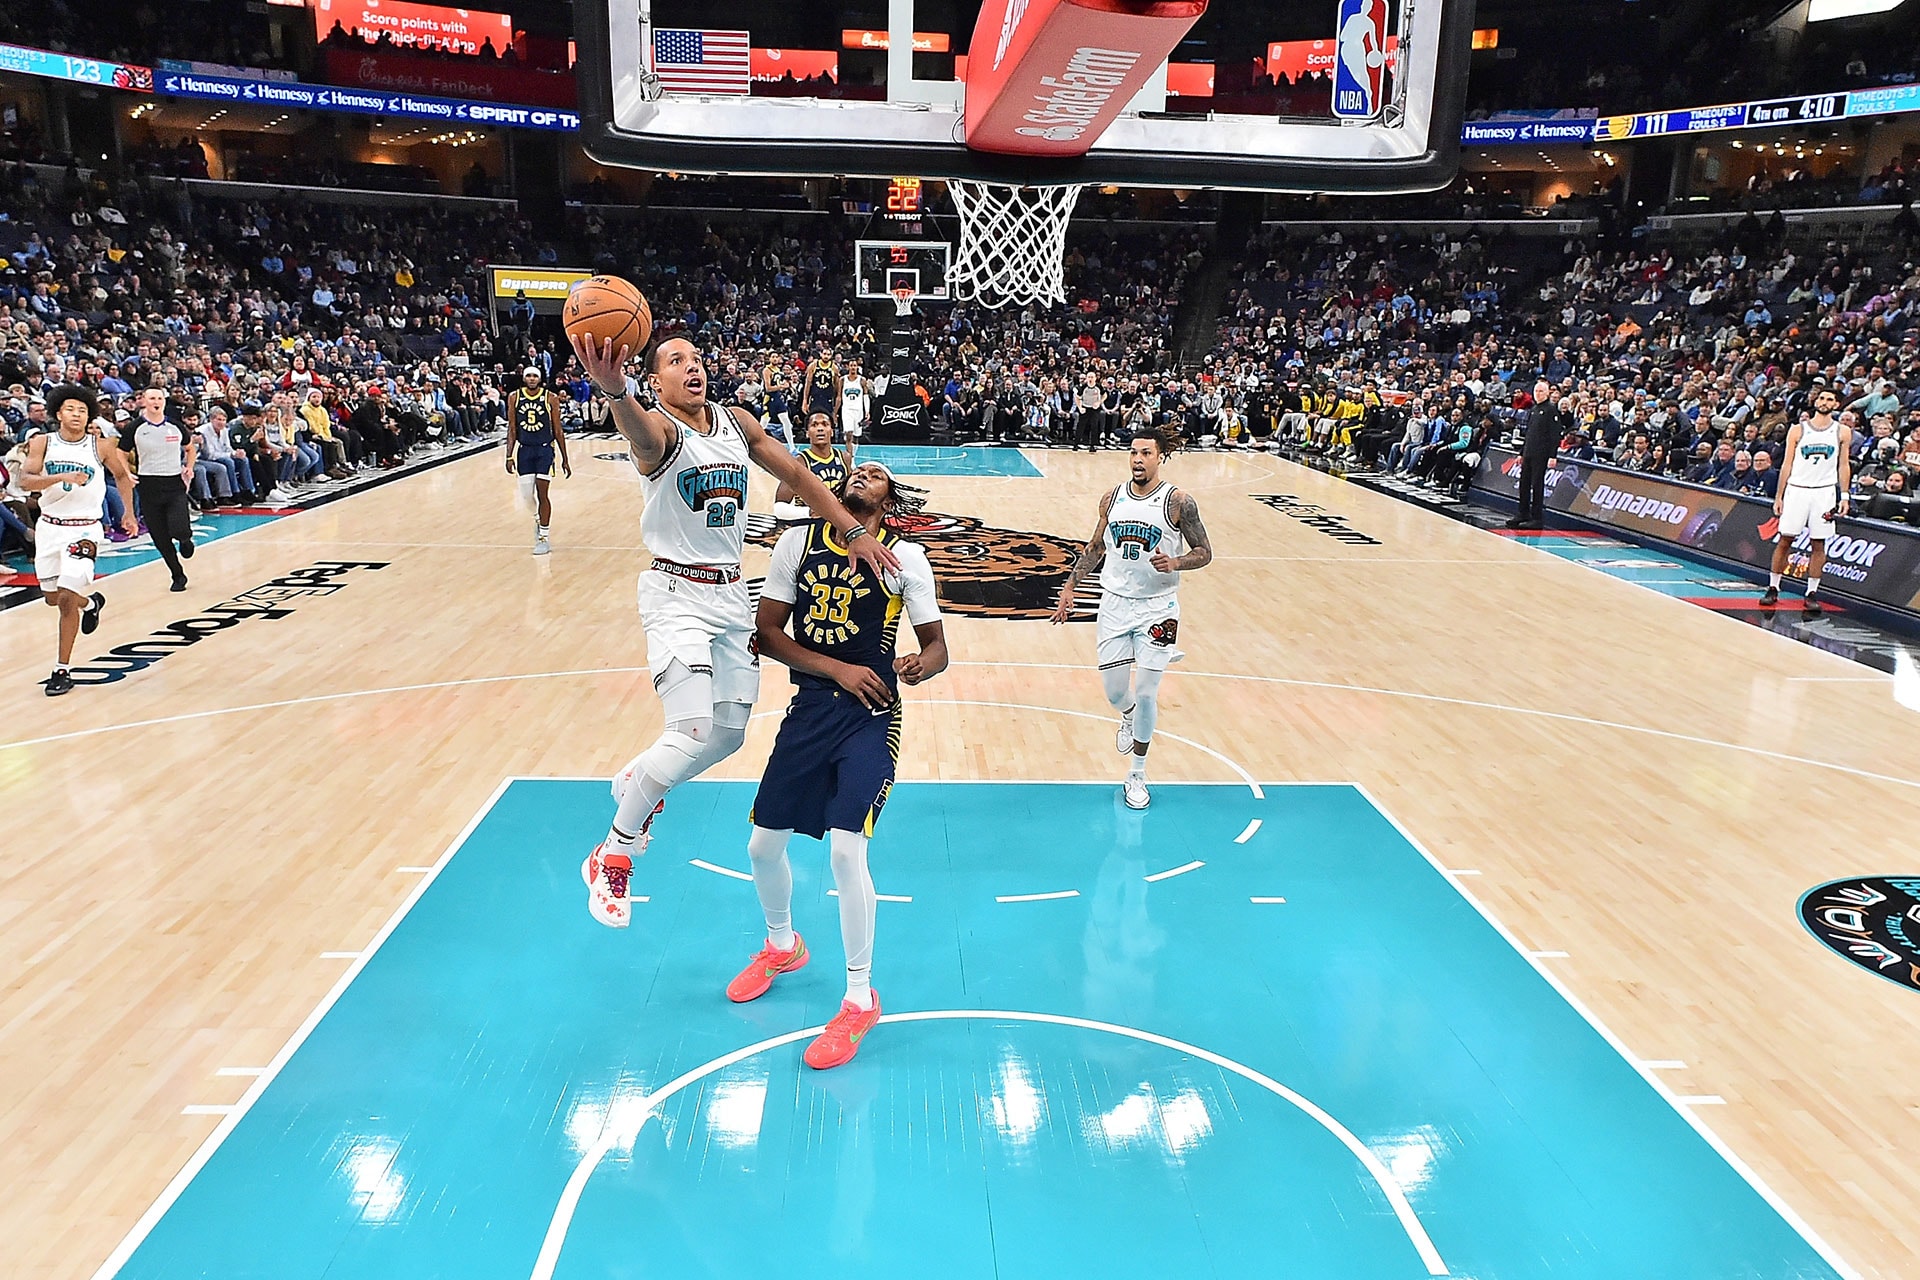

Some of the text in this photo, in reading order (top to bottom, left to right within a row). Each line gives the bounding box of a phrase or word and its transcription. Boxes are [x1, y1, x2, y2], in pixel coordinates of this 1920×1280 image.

[357, 27, 380, 40] the
[362, 11, 467, 34] Score points with
[63, 57, 101, 81] 123
[1307, 54, 1336, 65] Scor
[432, 77, 494, 96] FanDeck
[181, 77, 240, 98] Hennessy
[258, 84, 315, 104] Hennessy
[331, 91, 385, 111] Hennessy
[401, 98, 453, 117] Hennessy
[469, 106, 529, 123] SPIRIT
[530, 112, 557, 126] OF
[1339, 90, 1363, 111] NBA
[1752, 96, 1836, 121] 4TH QTR 4:10
[1465, 123, 1588, 141] Hennessy Hennessy
[1645, 114, 1669, 133] 111
[887, 186, 917, 210] 22
[527, 410, 536, 424] 5
[886, 410, 915, 420] SONIC
[1813, 456, 1820, 465] 7
[676, 464, 748, 513] GRIZZLIES
[706, 501, 737, 528] 22
[1108, 520, 1163, 553] GRIZZLIES
[1122, 542, 1140, 561] 15
[798, 563, 872, 599] INDIANA
[1822, 561, 1868, 583] emotion
[809, 583, 853, 624] 33
[803, 613, 860, 646] PACERS
